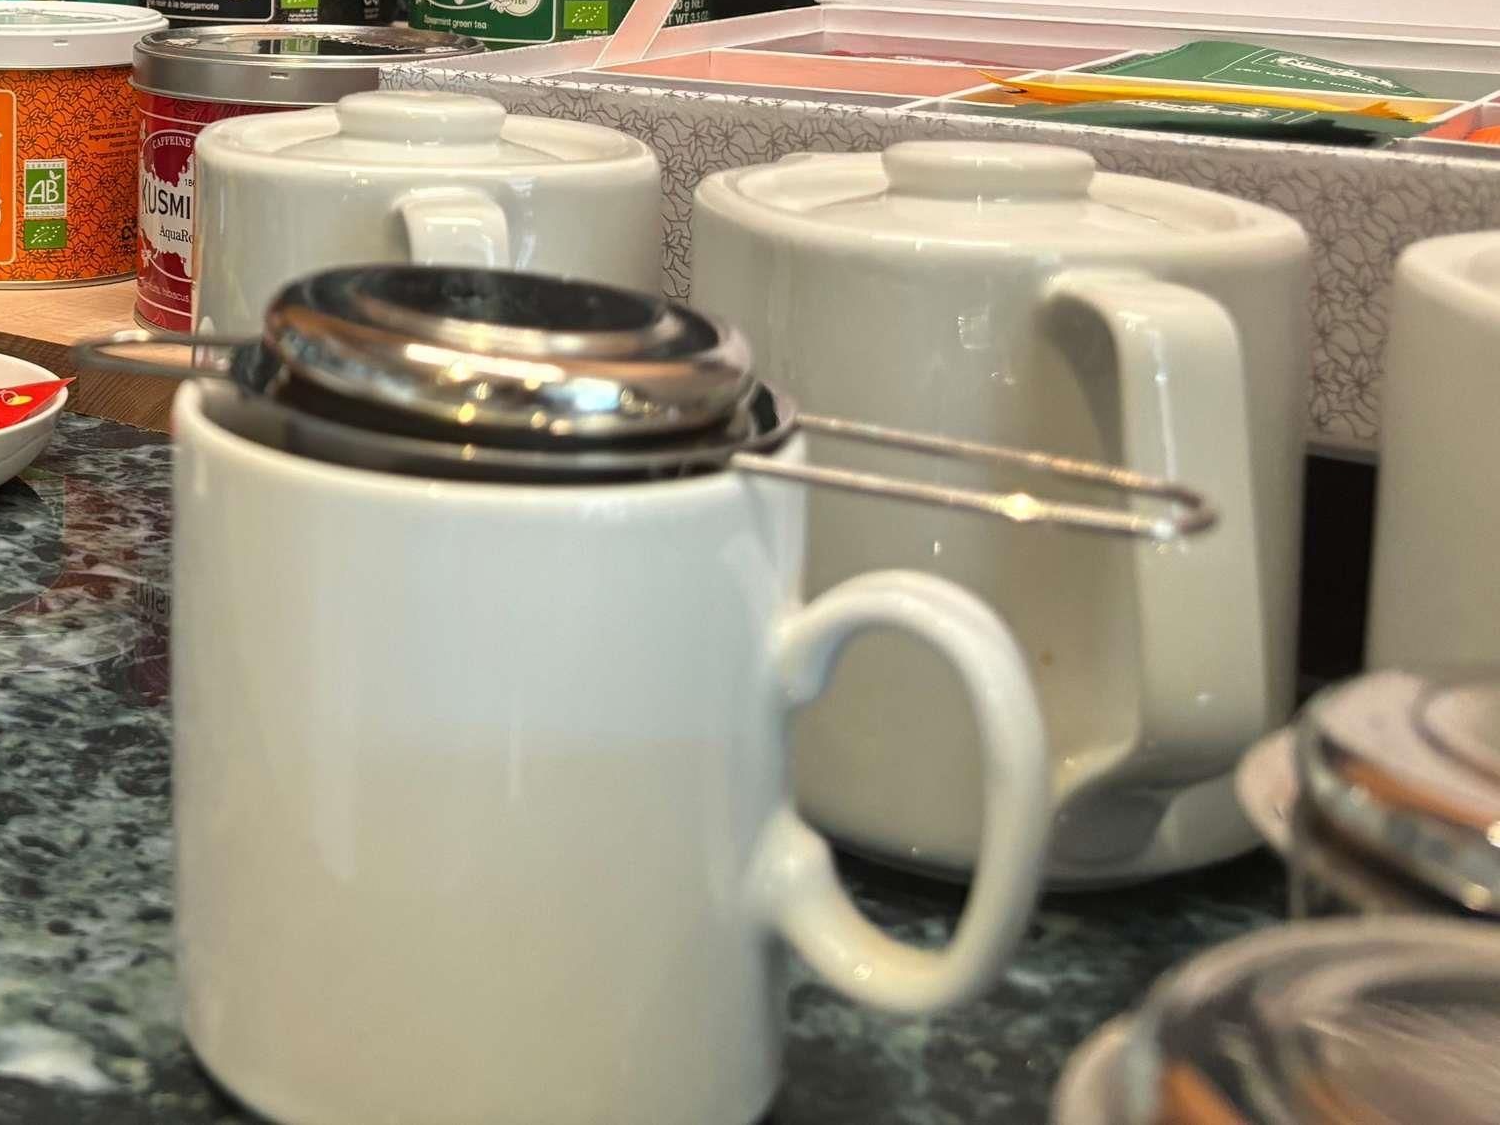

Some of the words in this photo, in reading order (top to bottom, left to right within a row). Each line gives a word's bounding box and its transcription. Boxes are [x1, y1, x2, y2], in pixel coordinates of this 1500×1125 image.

[180, 1, 219, 11] bergamote
[152, 135, 191, 150] CAFFEINE
[28, 179, 59, 203] AB
[142, 177, 191, 221] KUSMI
